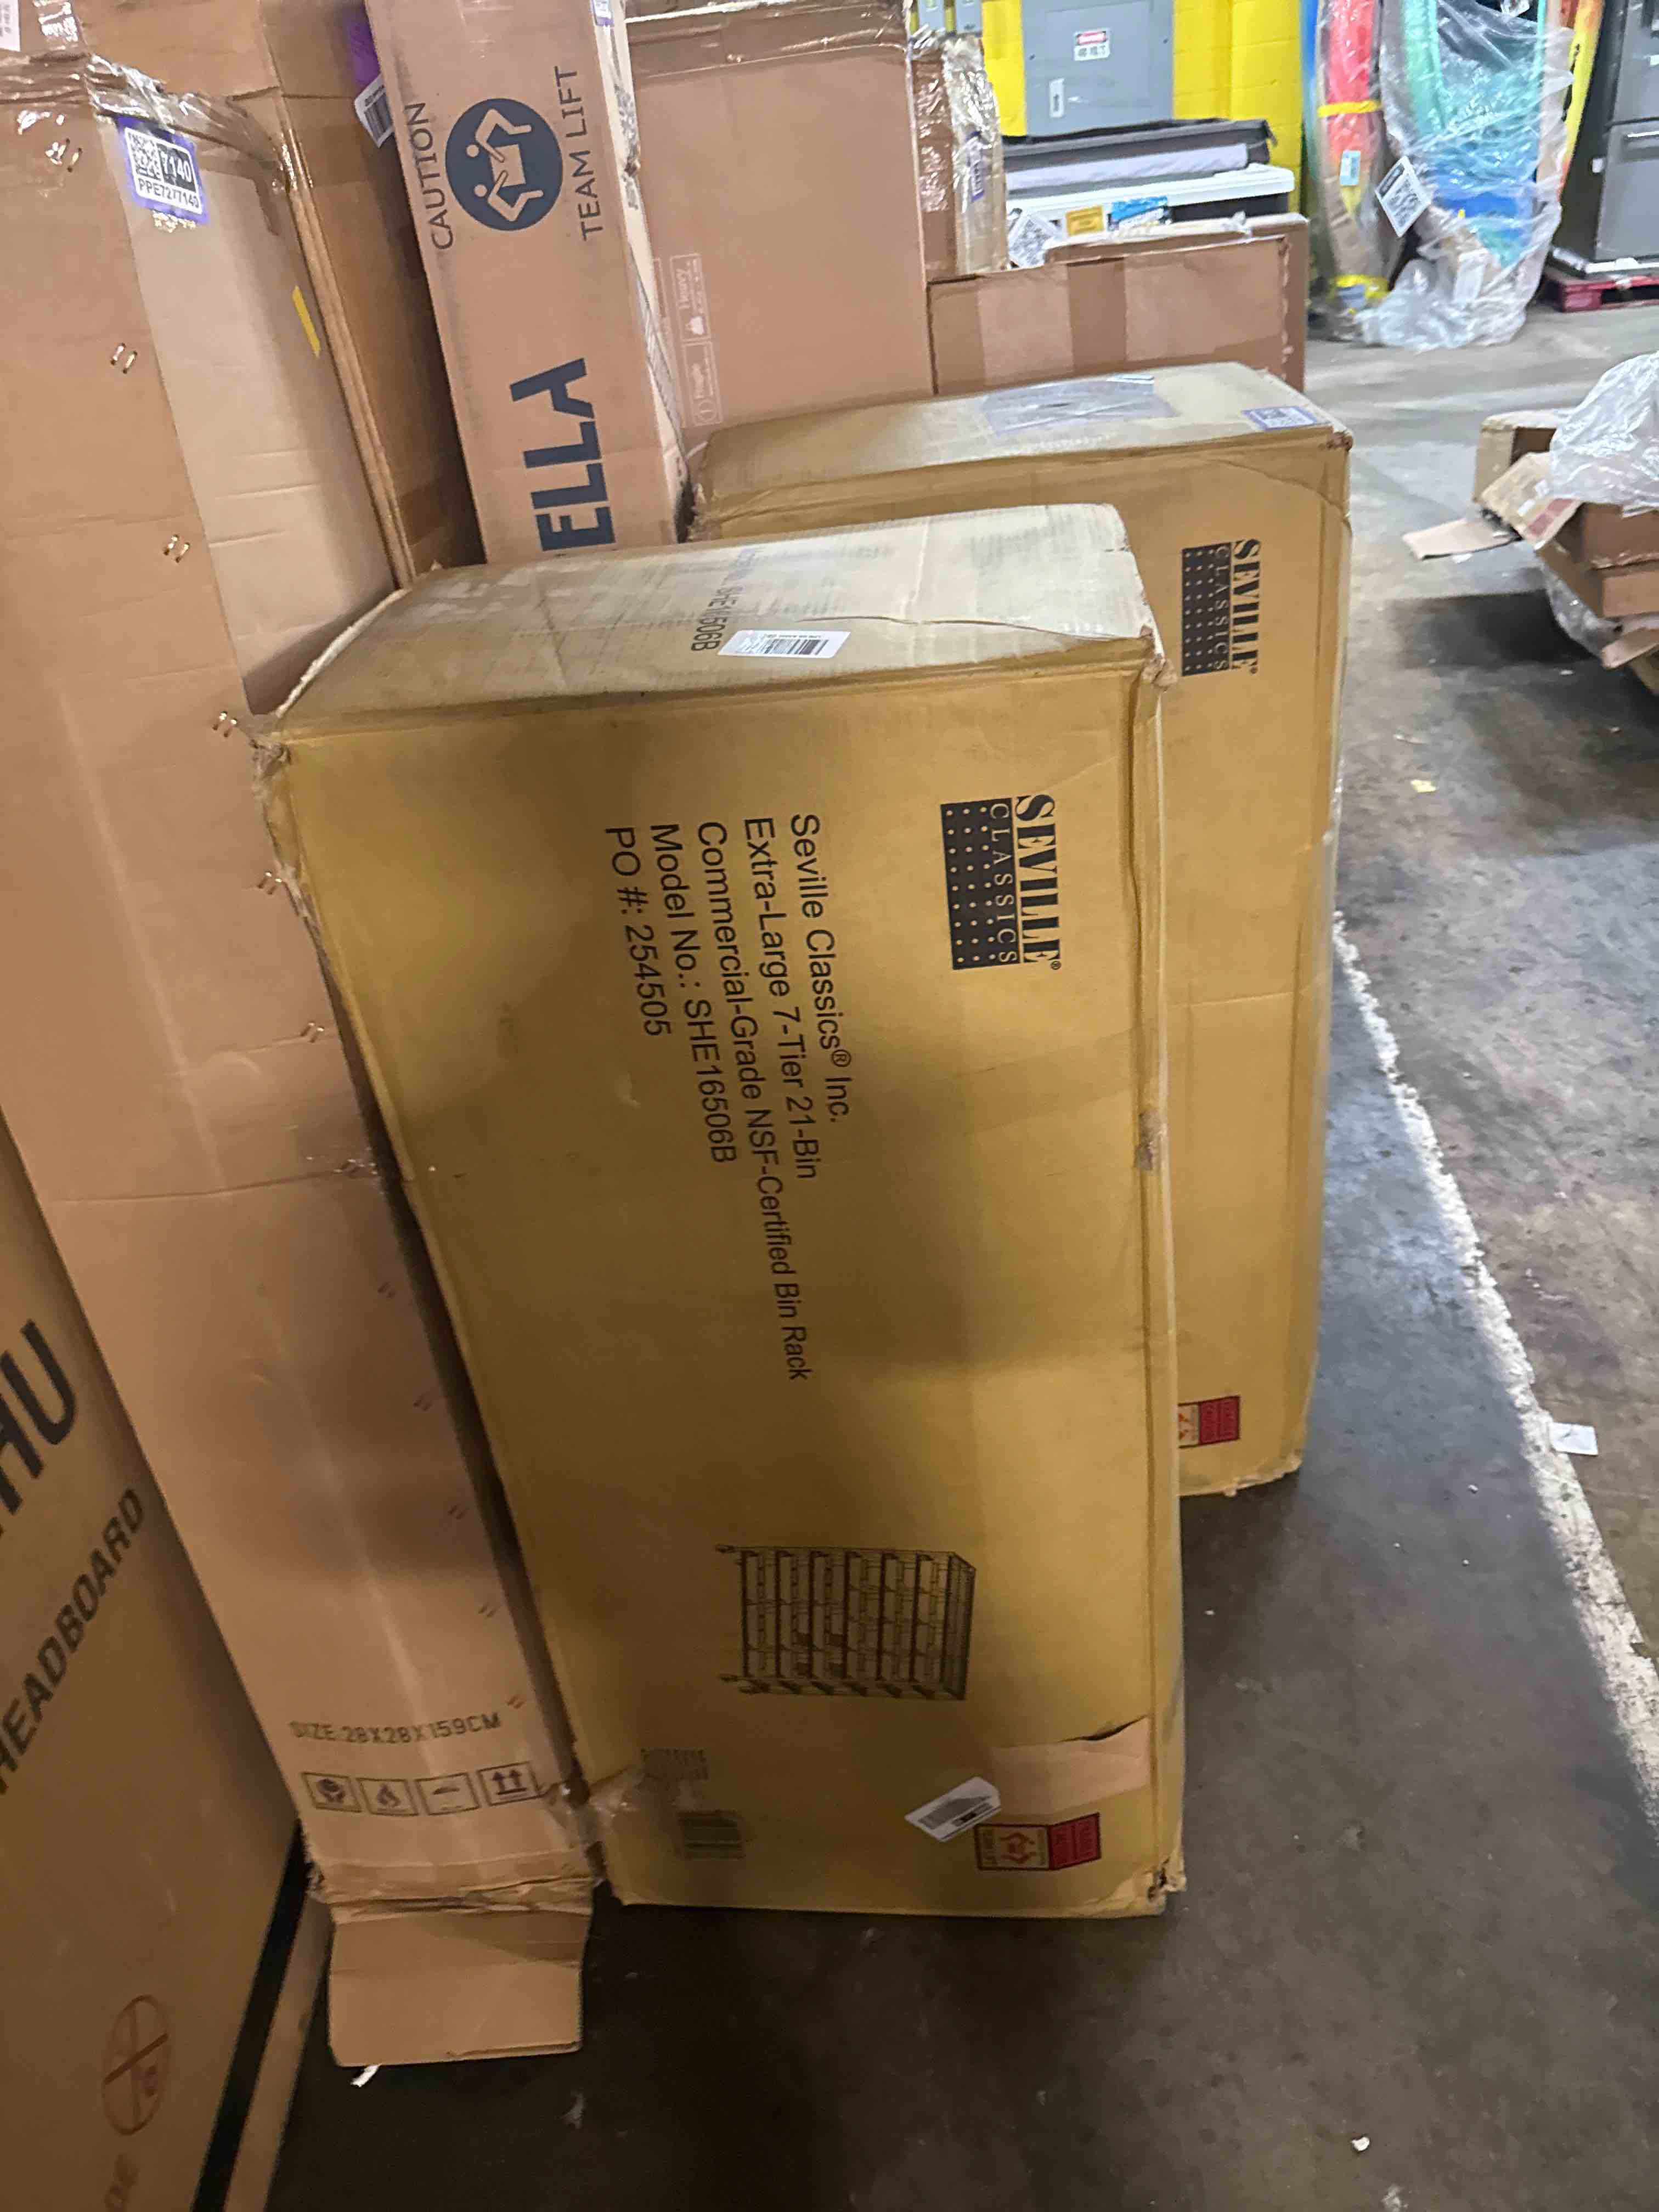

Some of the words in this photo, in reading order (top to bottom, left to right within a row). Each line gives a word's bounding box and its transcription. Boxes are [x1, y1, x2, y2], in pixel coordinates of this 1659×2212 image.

[555, 66, 588, 137] LIFT
[160, 150, 191, 182] 7140
[404, 102, 454, 250] CAUTION
[569, 150, 603, 241] TEAM
[510, 358, 616, 551] ELLA
[1213, 546, 1229, 669] CLASSICS
[1232, 538, 1260, 670] SEVILLE
[604, 827, 641, 877] PO
[616, 886, 649, 915] #:
[650, 823, 695, 918] Model
[990, 803, 1018, 963] CLASSICS
[670, 929, 701, 988] No.:
[744, 817, 791, 997] Extra-Large
[624, 924, 672, 1036] 254505
[697, 821, 766, 1099] Commercial-Grade
[791, 814, 829, 918] Seville
[825, 1077, 853, 1123] Inc.
[684, 999, 737, 1163] SHE16506B
[772, 1006, 806, 1088] 7-Tier
[786, 1096, 821, 1178] 21-Bin
[744, 1109, 797, 1274] NSF-Certified
[774, 1283, 800, 1318] Bin
[781, 1326, 813, 1380] Rack
